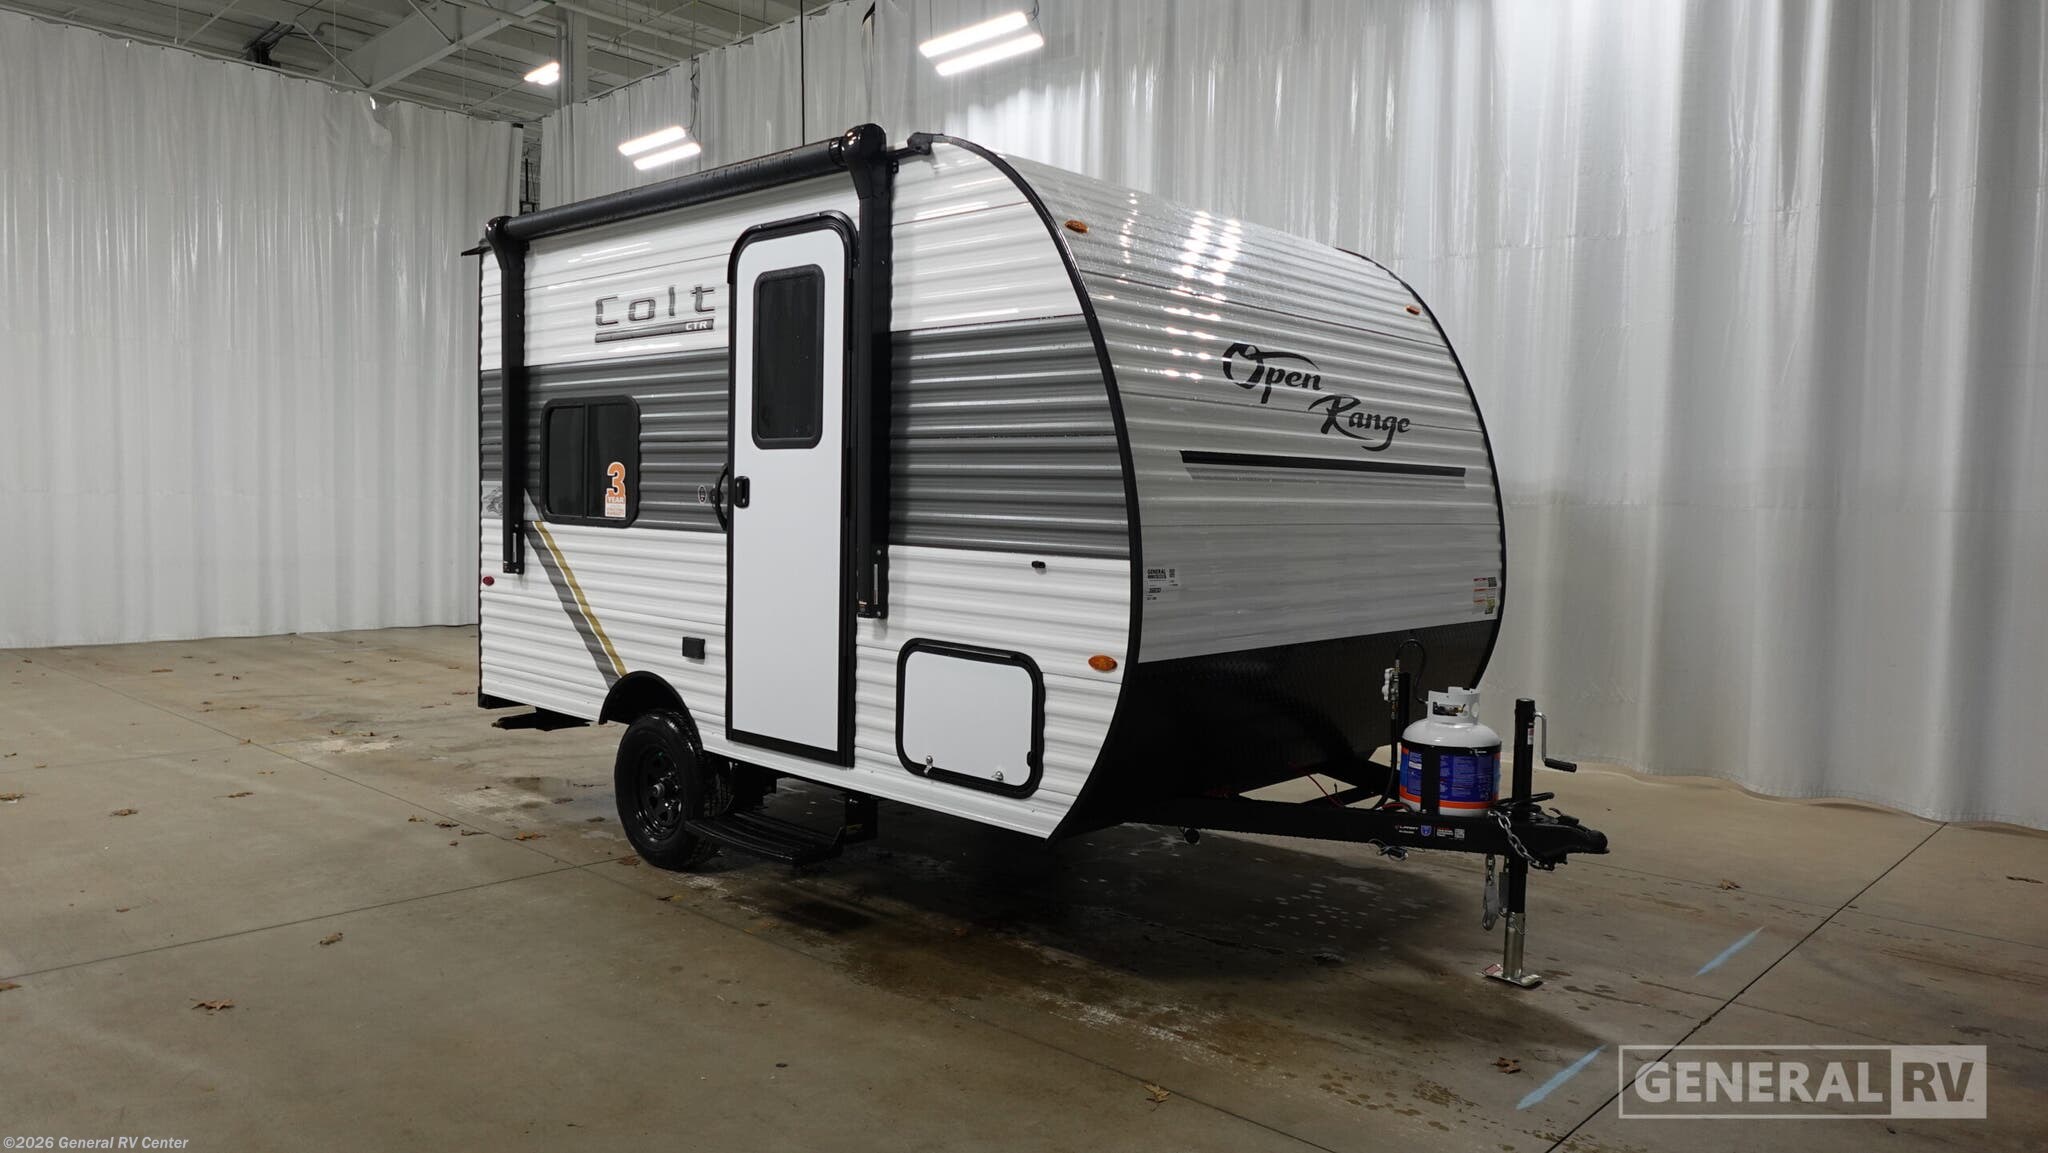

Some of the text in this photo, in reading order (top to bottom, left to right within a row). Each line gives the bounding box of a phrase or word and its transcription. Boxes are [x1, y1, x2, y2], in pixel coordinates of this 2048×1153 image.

[595, 286, 716, 326] Colt
[685, 320, 708, 331] CTR
[1222, 342, 1321, 404] Open
[1308, 394, 1411, 452] Range
[606, 461, 626, 498] 3
